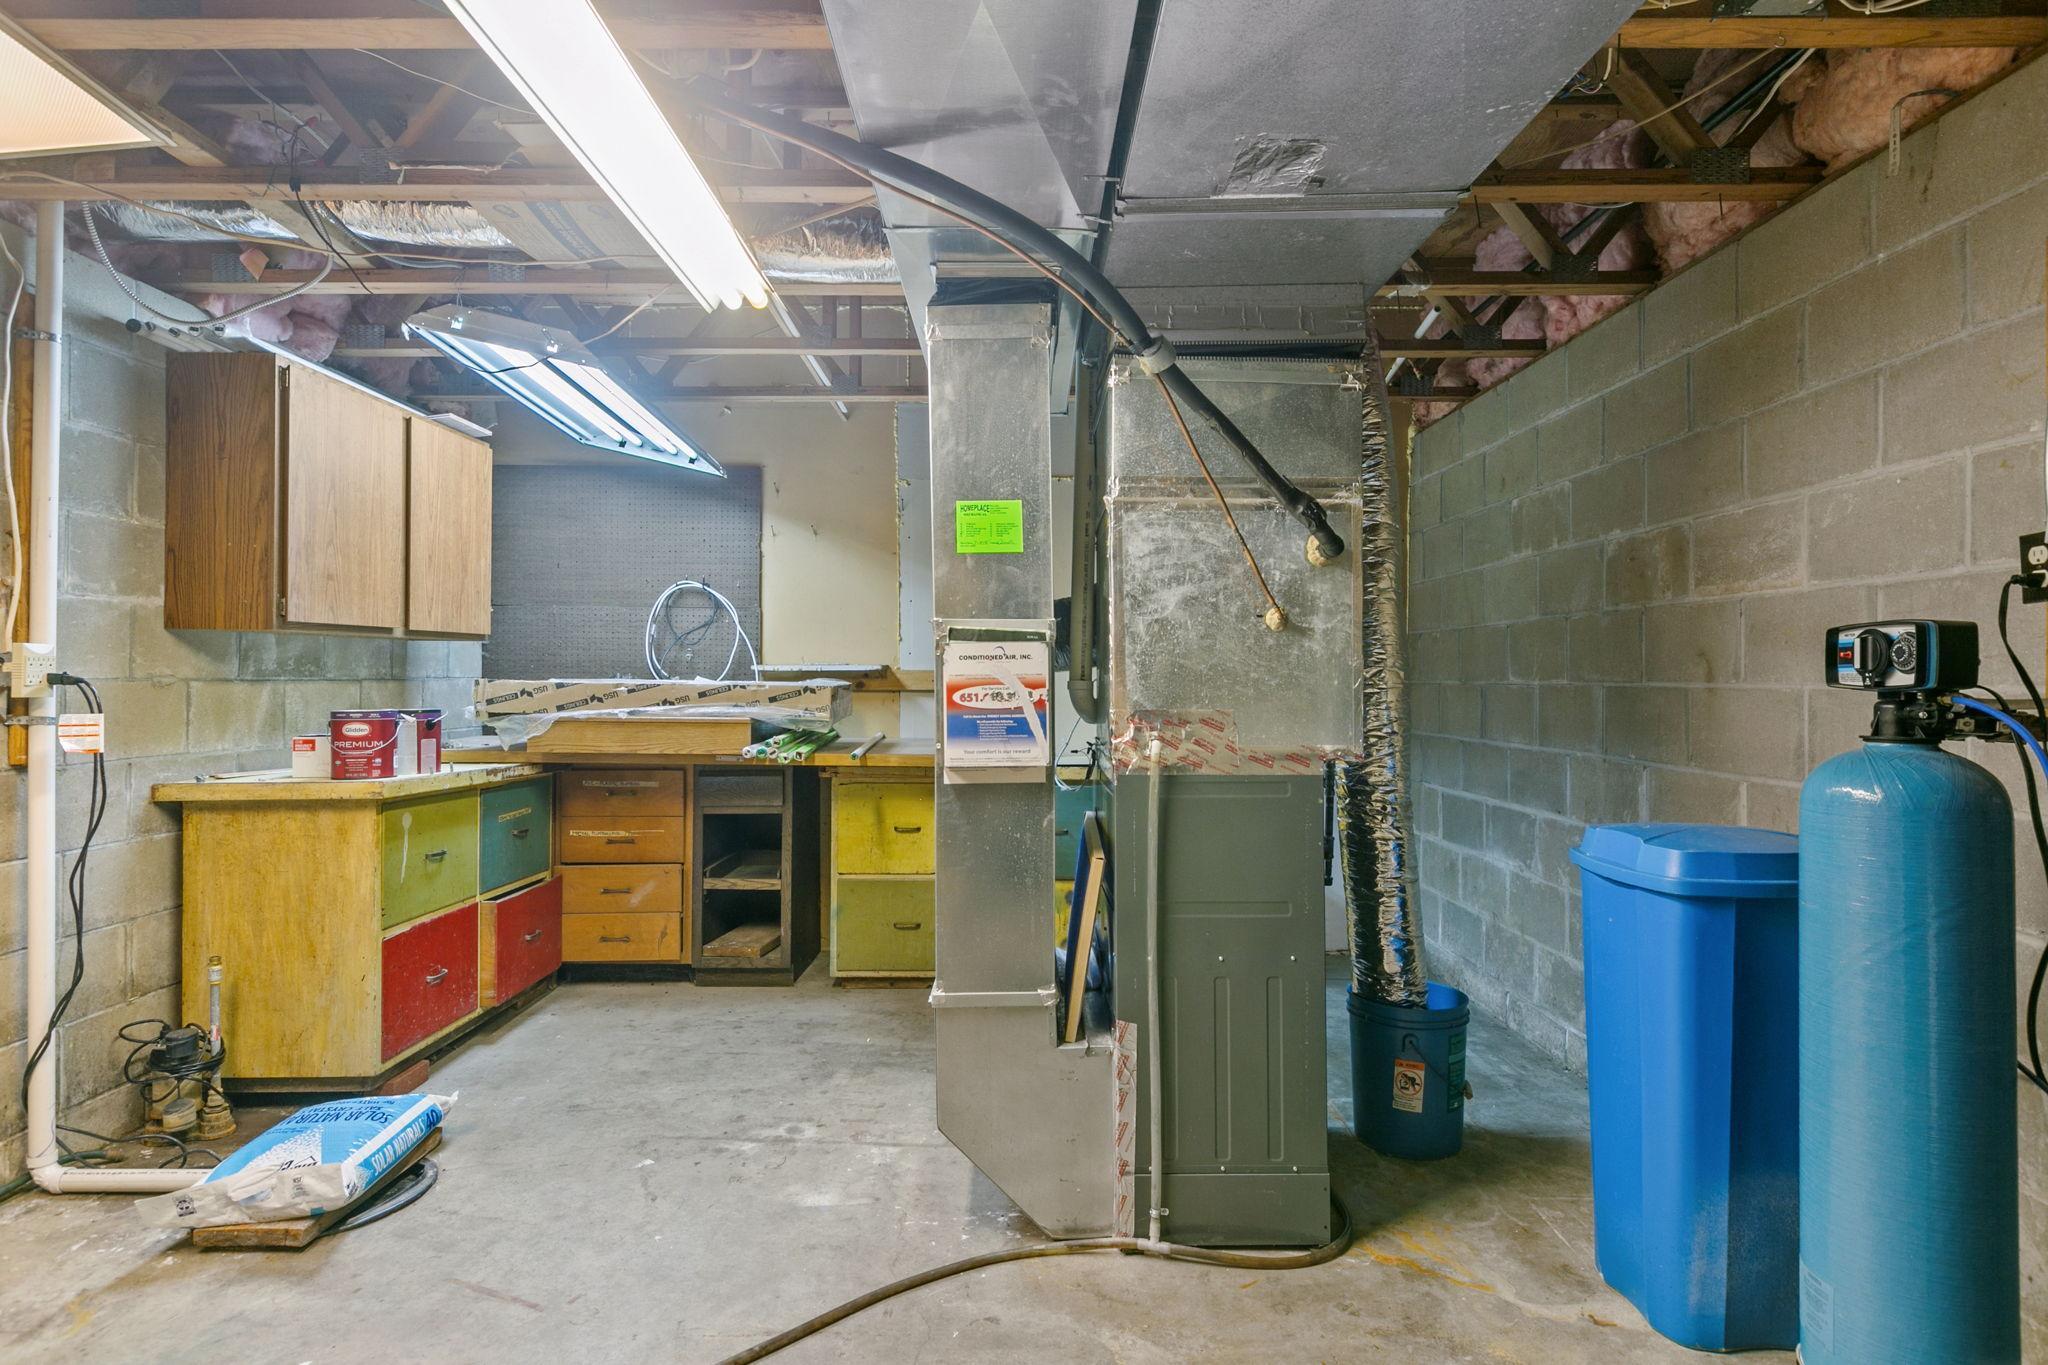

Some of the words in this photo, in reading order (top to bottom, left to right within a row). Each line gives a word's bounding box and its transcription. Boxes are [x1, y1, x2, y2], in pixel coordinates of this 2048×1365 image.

[532, 685, 548, 695] USG
[603, 691, 619, 700] USG
[674, 695, 690, 704] USG
[345, 1110, 393, 1123] SOLAR
[371, 1142, 396, 1176] SOLAR
[392, 1116, 426, 1155] NATURALS
[425, 1109, 438, 1131] 40
